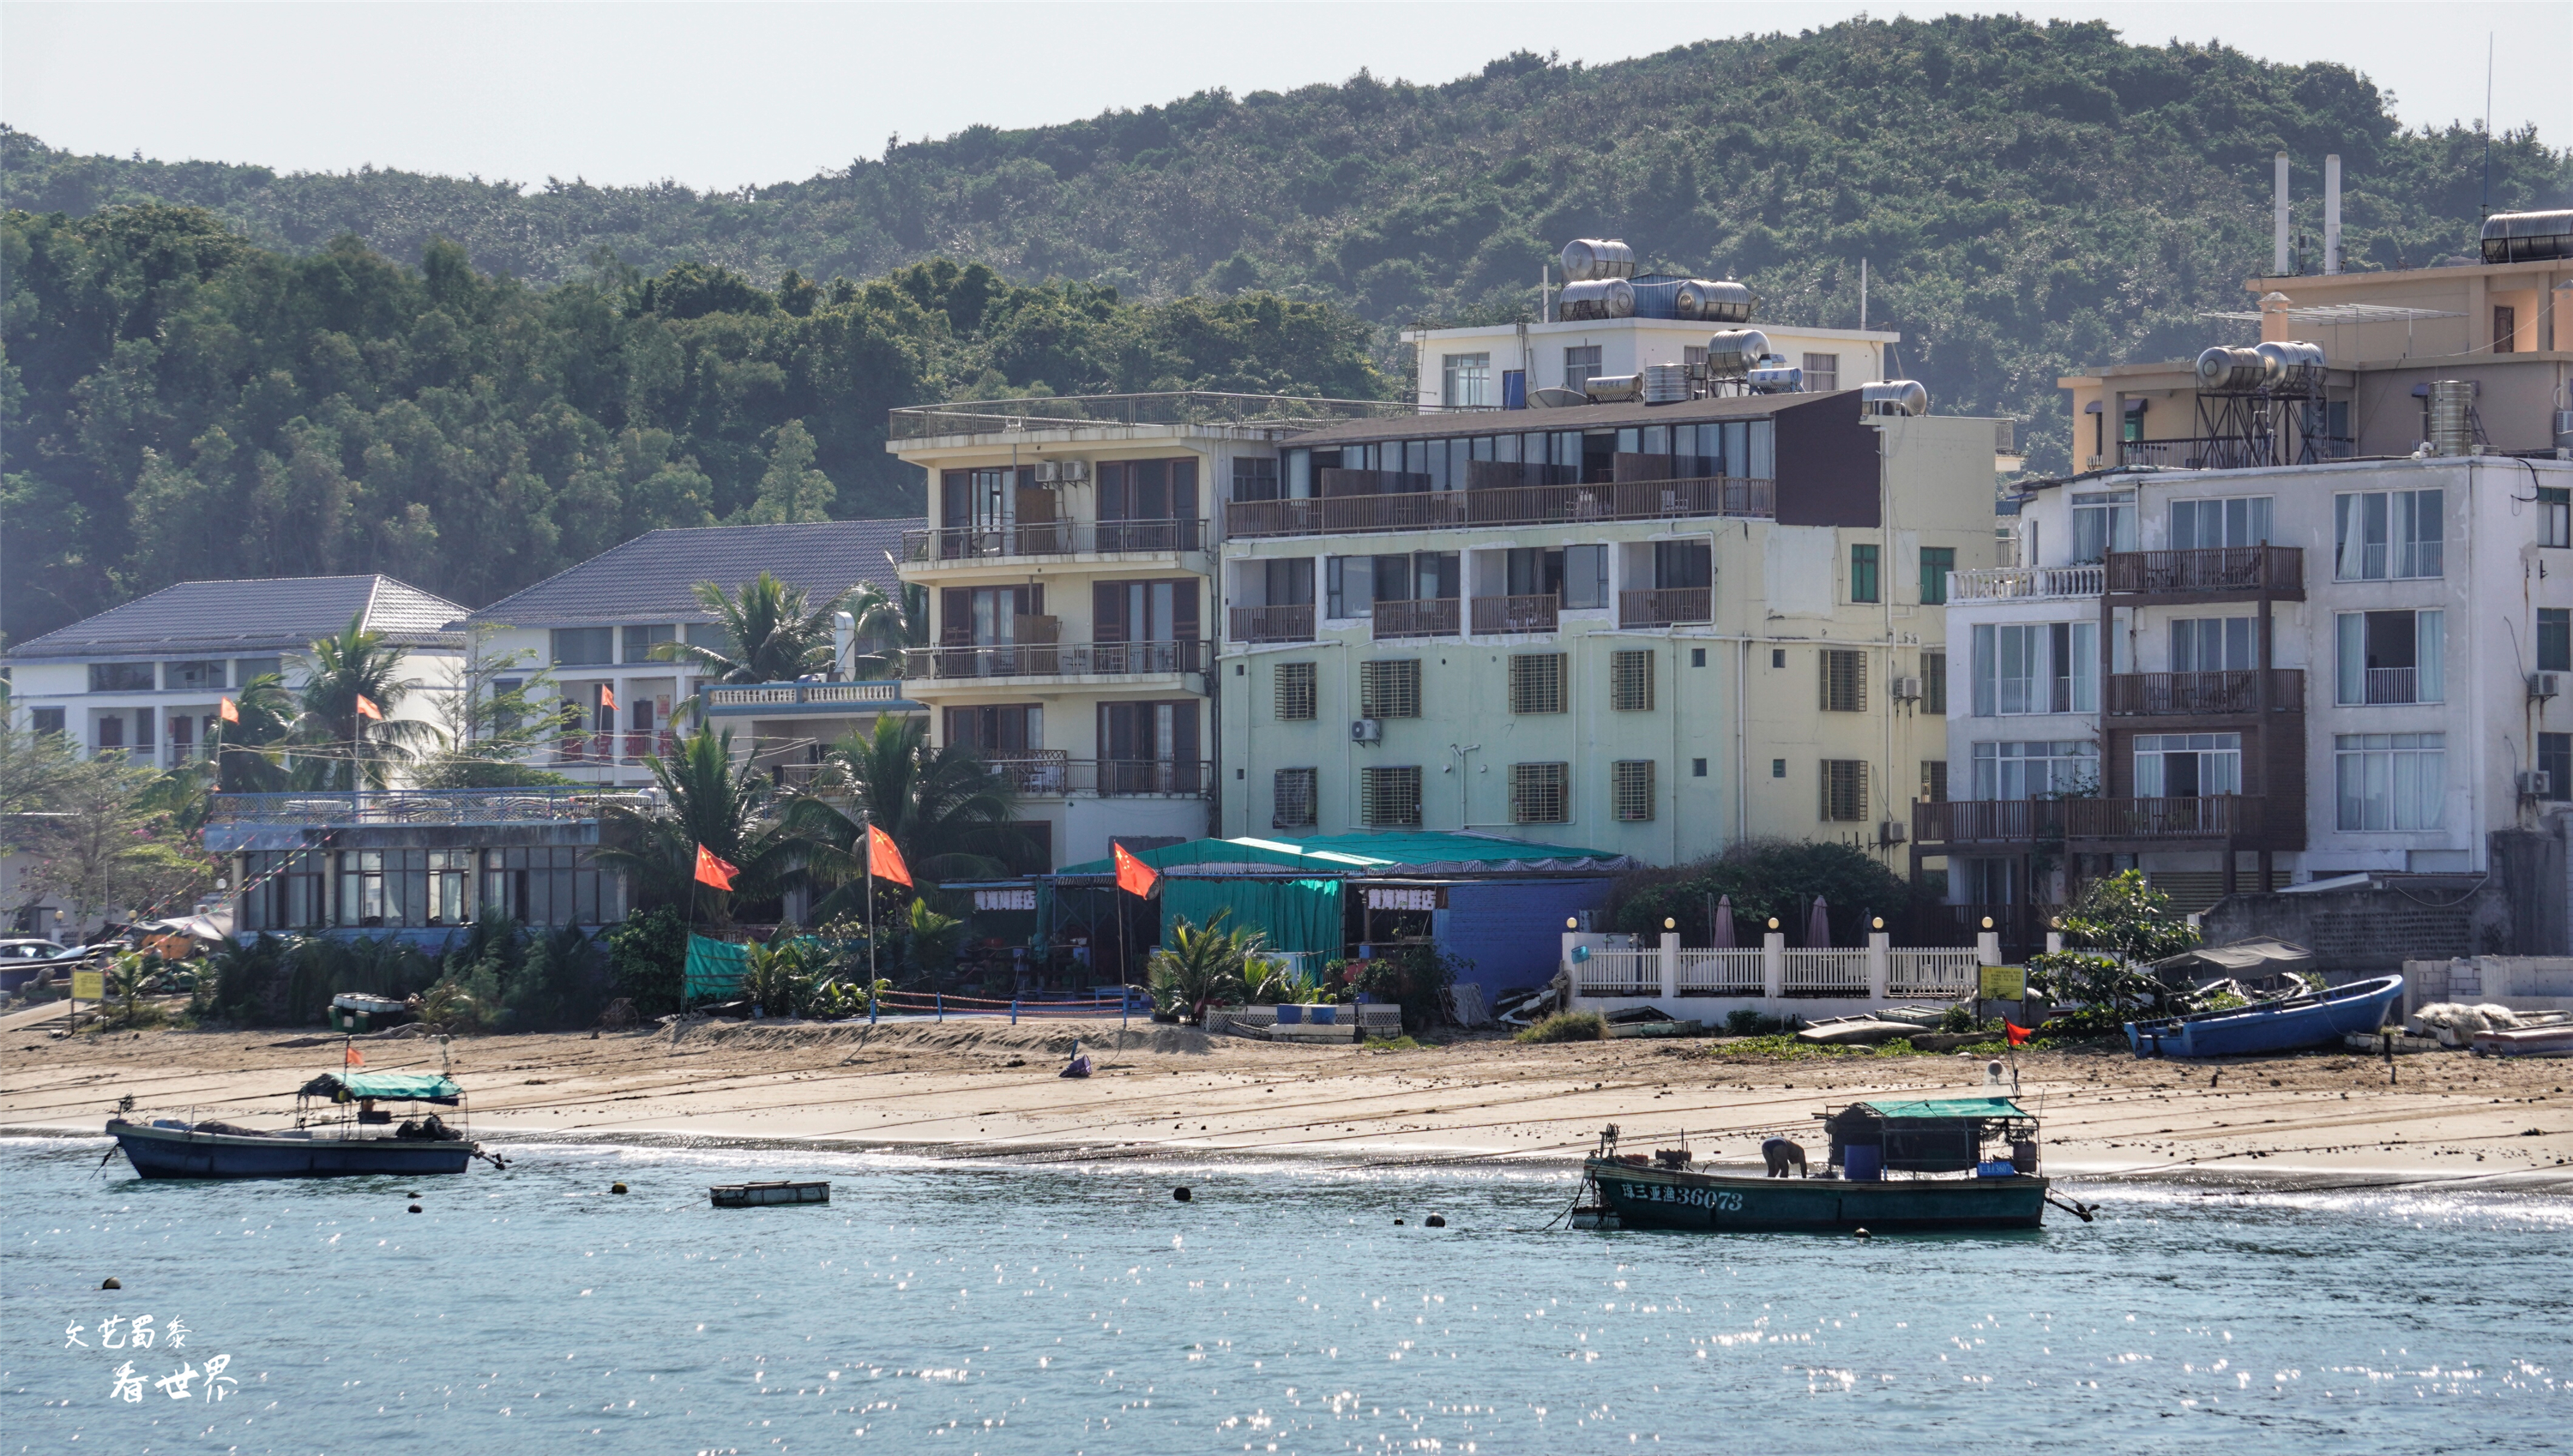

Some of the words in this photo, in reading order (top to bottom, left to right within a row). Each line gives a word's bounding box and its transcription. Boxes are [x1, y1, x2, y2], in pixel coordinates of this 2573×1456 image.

[1368, 889, 1437, 911] 黄海海鲜店
